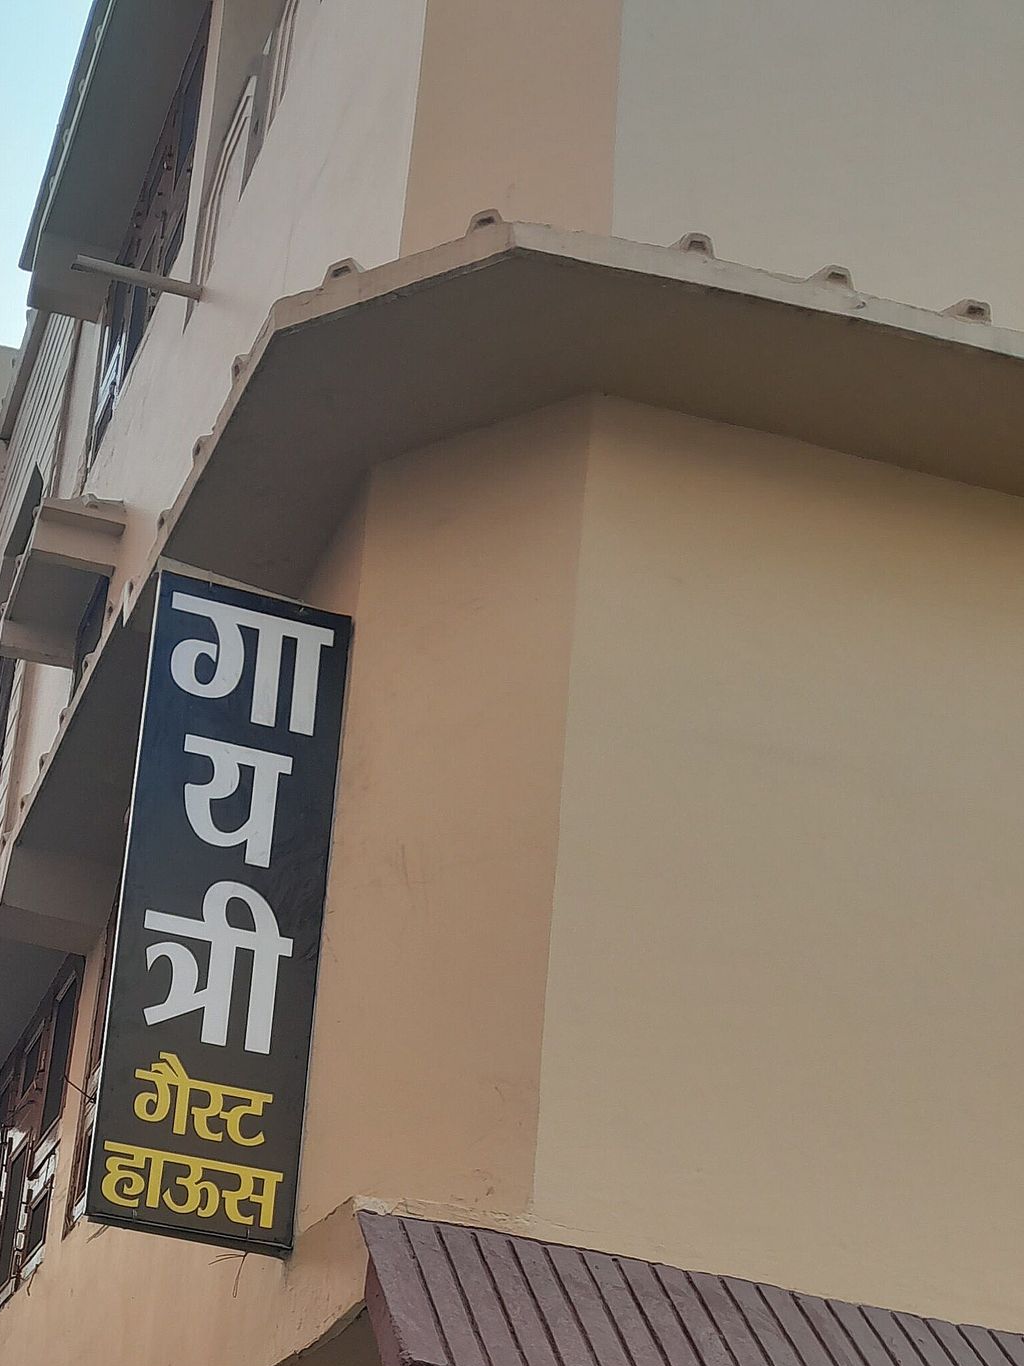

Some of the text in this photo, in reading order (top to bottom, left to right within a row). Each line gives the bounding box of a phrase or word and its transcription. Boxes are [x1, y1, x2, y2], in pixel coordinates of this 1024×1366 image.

[144, 591, 335, 1055] गायत्री
[133, 1051, 274, 1146] गैस्ट
[100, 1140, 284, 1229] हाऊस
